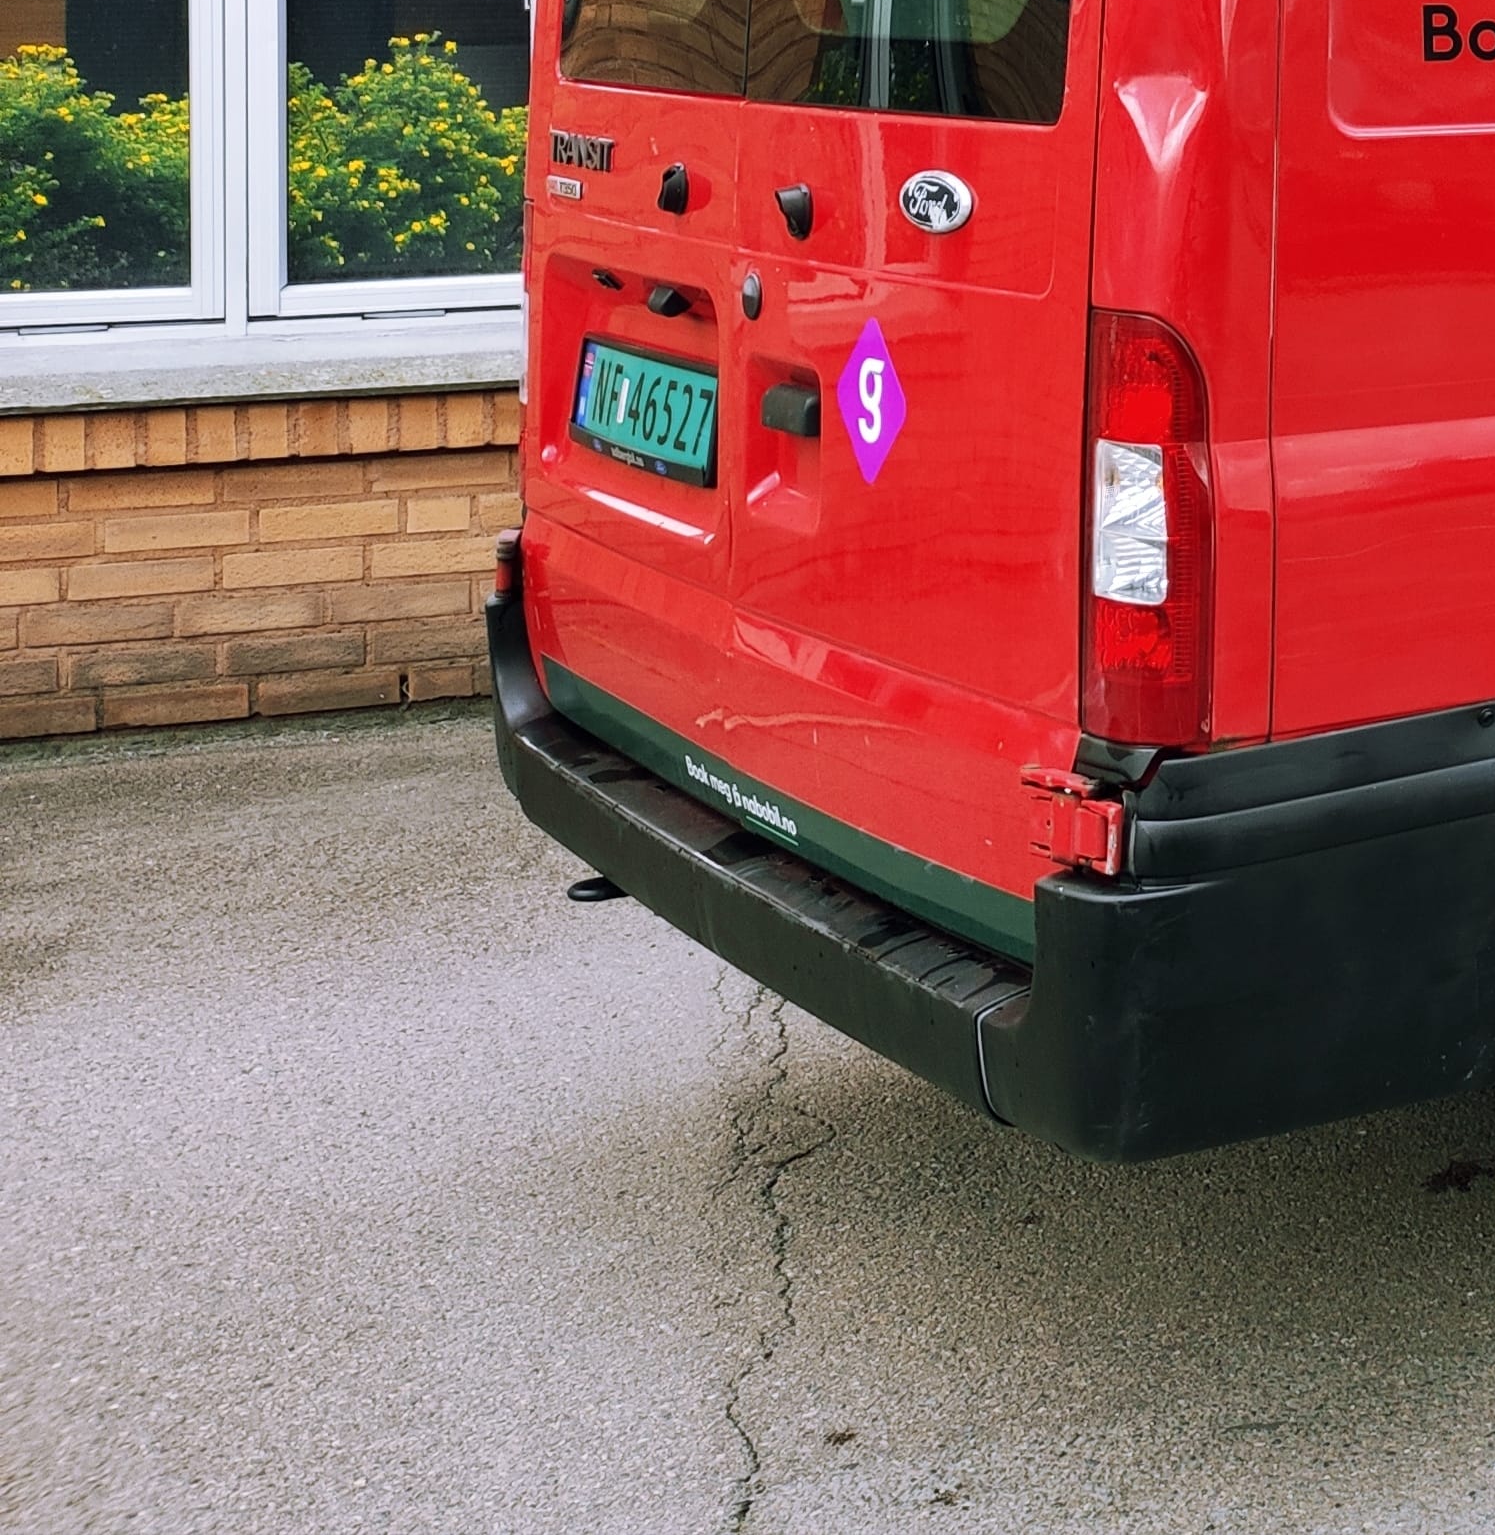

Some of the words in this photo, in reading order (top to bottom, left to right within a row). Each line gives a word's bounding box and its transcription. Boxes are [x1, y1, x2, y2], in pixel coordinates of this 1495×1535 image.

[550, 129, 615, 172] TRANSIT
[592, 359, 624, 427] NF
[628, 371, 714, 456] 46527
[685, 754, 711, 787] Book
[709, 773, 733, 805] meg
[742, 793, 797, 837] nabobil.no
